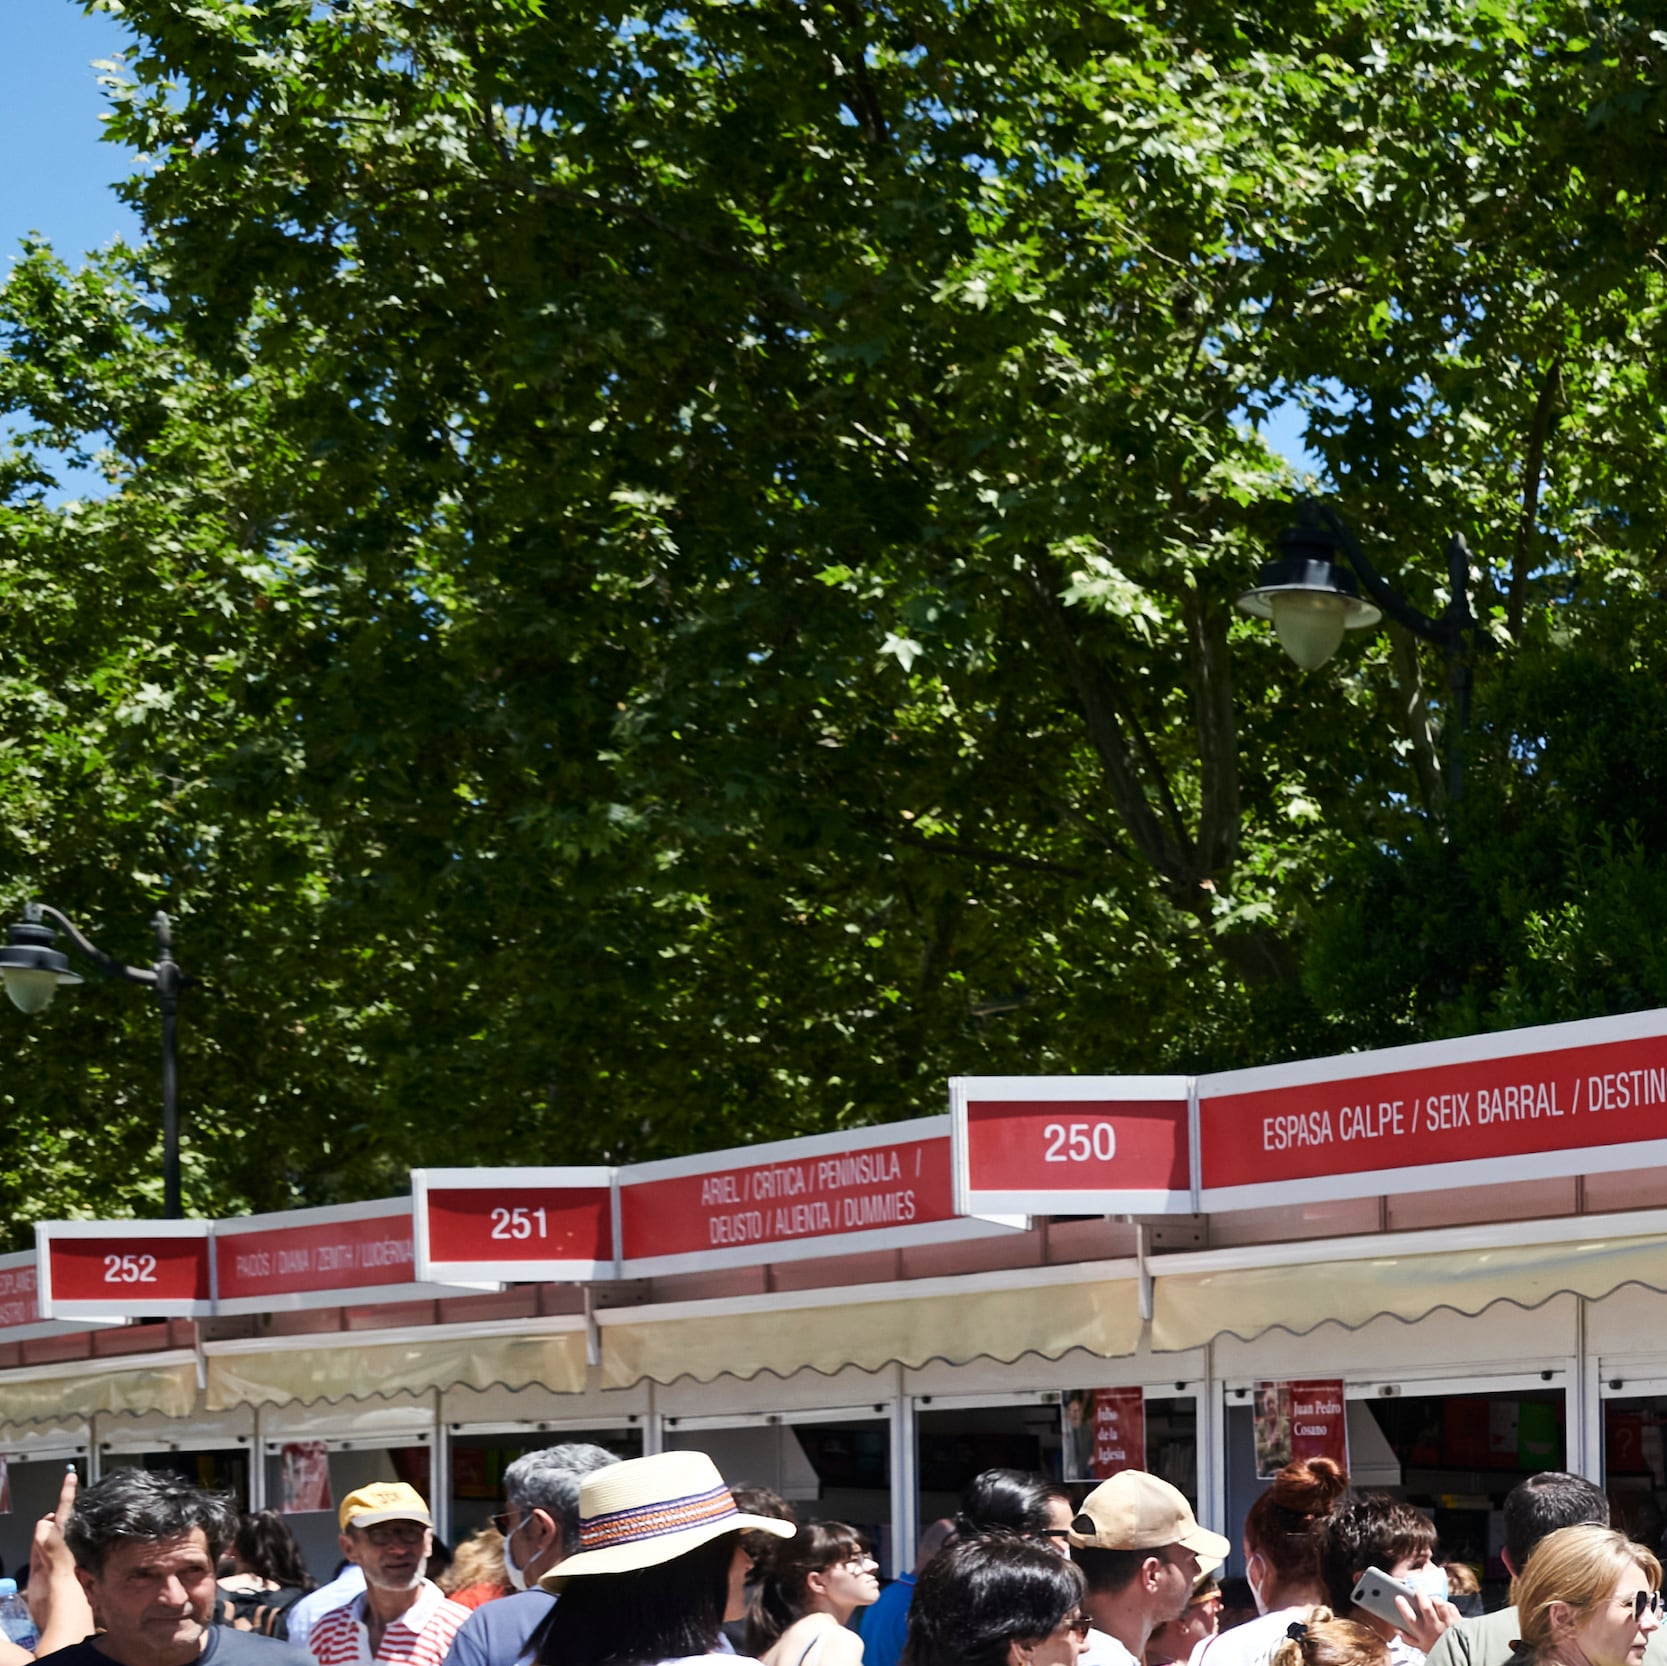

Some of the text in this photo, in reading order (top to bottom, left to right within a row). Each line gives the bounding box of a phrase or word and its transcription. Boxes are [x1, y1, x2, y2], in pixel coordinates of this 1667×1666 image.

[1263, 1109, 1334, 1152] ESPASA
[1338, 1099, 1405, 1142] CALPE
[1411, 1098, 1420, 1134] /
[1425, 1092, 1472, 1132] SEIX
[1477, 1081, 1565, 1126] BARRAL
[1571, 1078, 1580, 1114] /
[1043, 1123, 1116, 1163] 250
[702, 1169, 741, 1207] ARIEL
[753, 1161, 806, 1200] CRÍTICA
[818, 1148, 901, 1189] PENÍNSULA
[490, 1207, 548, 1241] 251
[709, 1210, 764, 1245] DEUSTO
[775, 1200, 833, 1236] ALIENTA
[843, 1188, 917, 1229] DUMMIES
[104, 1254, 157, 1283] 252
[1097, 1407, 1118, 1423] Julio
[1293, 1400, 1341, 1418] Juan Pedro
[1098, 1428, 1118, 1441] de la
[1294, 1422, 1327, 1436] Cosano
[1098, 1447, 1125, 1465] Iglesia
